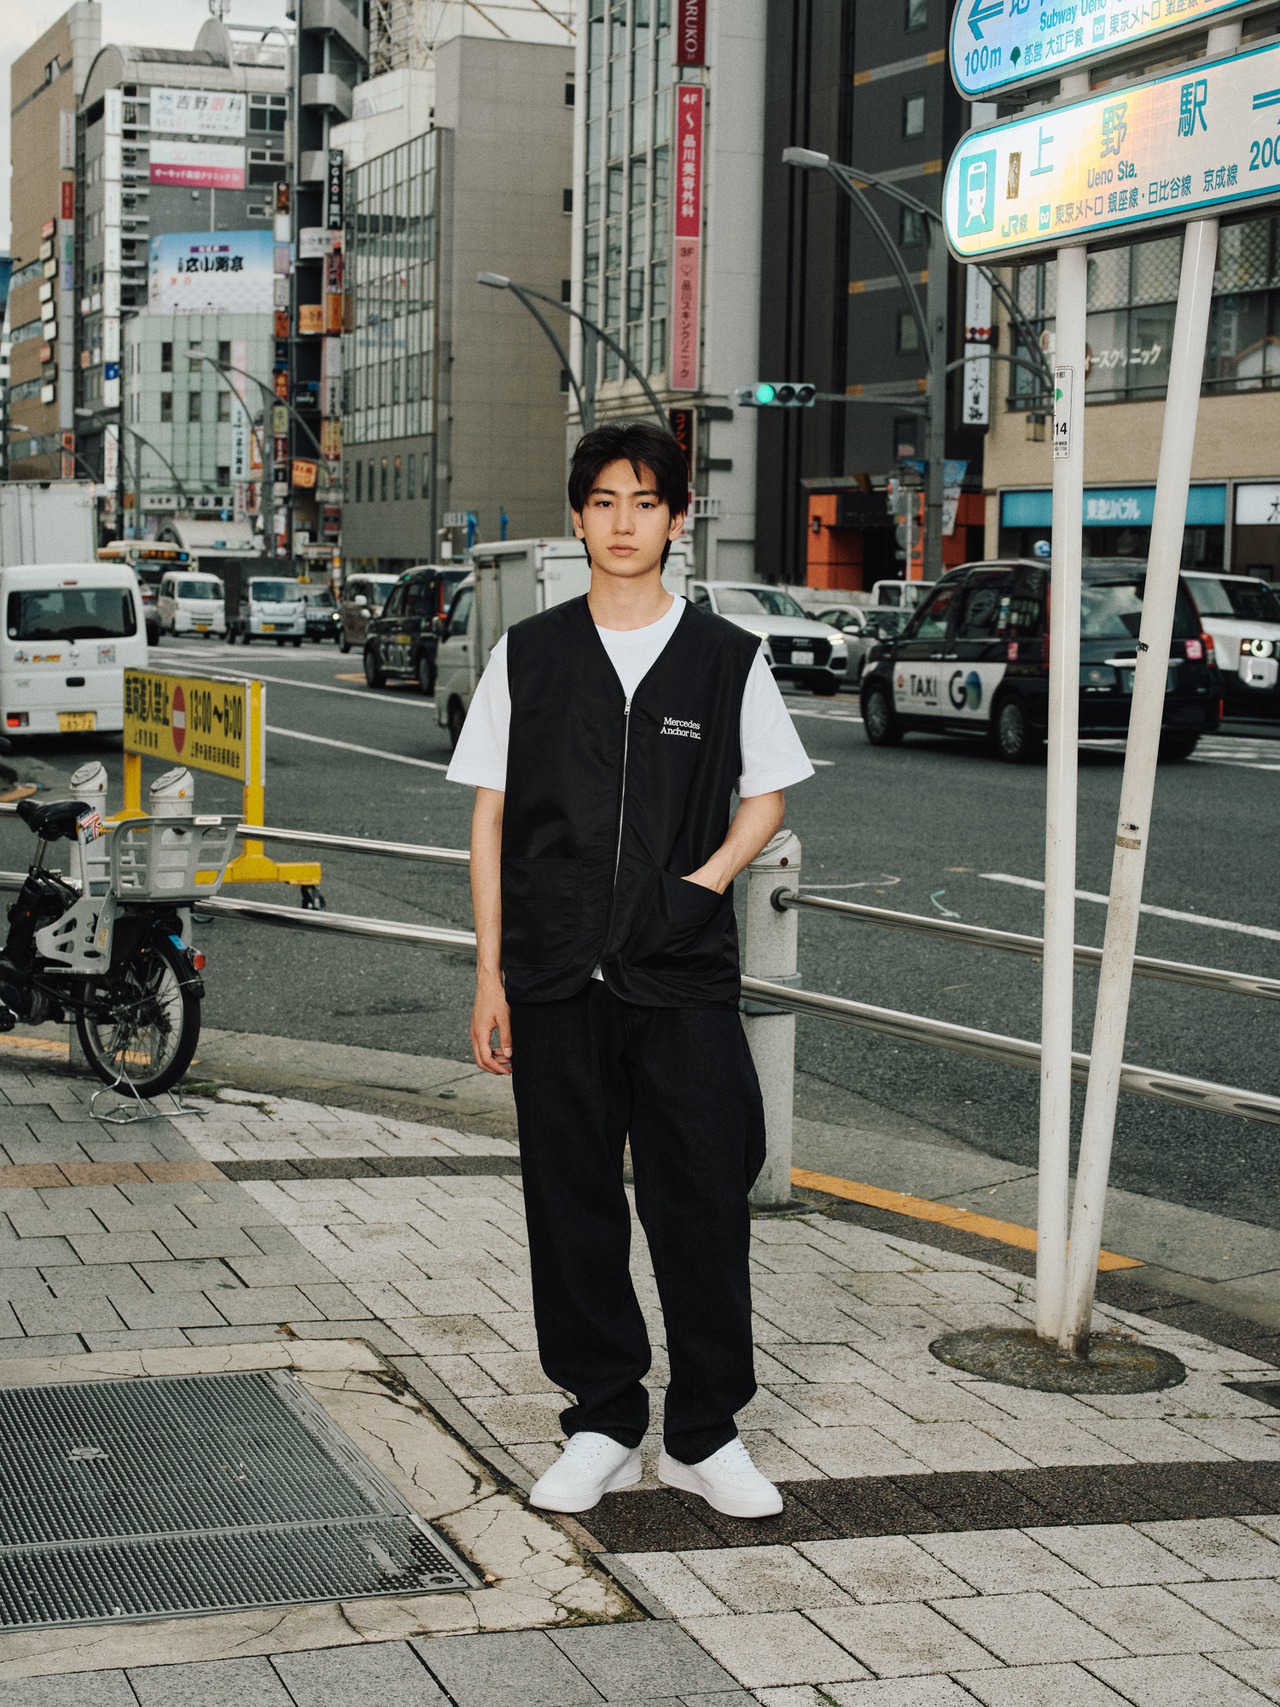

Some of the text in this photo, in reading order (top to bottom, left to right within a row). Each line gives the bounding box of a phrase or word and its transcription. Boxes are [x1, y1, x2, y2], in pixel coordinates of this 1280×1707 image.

[1040, 5, 1077, 31] Subway
[1024, 41, 1043, 66] 都営
[1046, 27, 1084, 59] 大江戸線
[1109, 2, 1161, 36] 東京メトロ
[965, 45, 1002, 77] 100m
[682, 93, 699, 105] 4F
[681, 133, 697, 218] 品川美容外科
[1087, 160, 1138, 189] Ueno Sta.
[1001, 214, 1029, 237] JR線
[1055, 196, 1104, 226] 東京メトロ
[1203, 163, 1238, 192] 京成線
[910, 674, 938, 697] TAXI
[660, 726, 689, 737] Anchor
[663, 716, 701, 730] Mercedes
